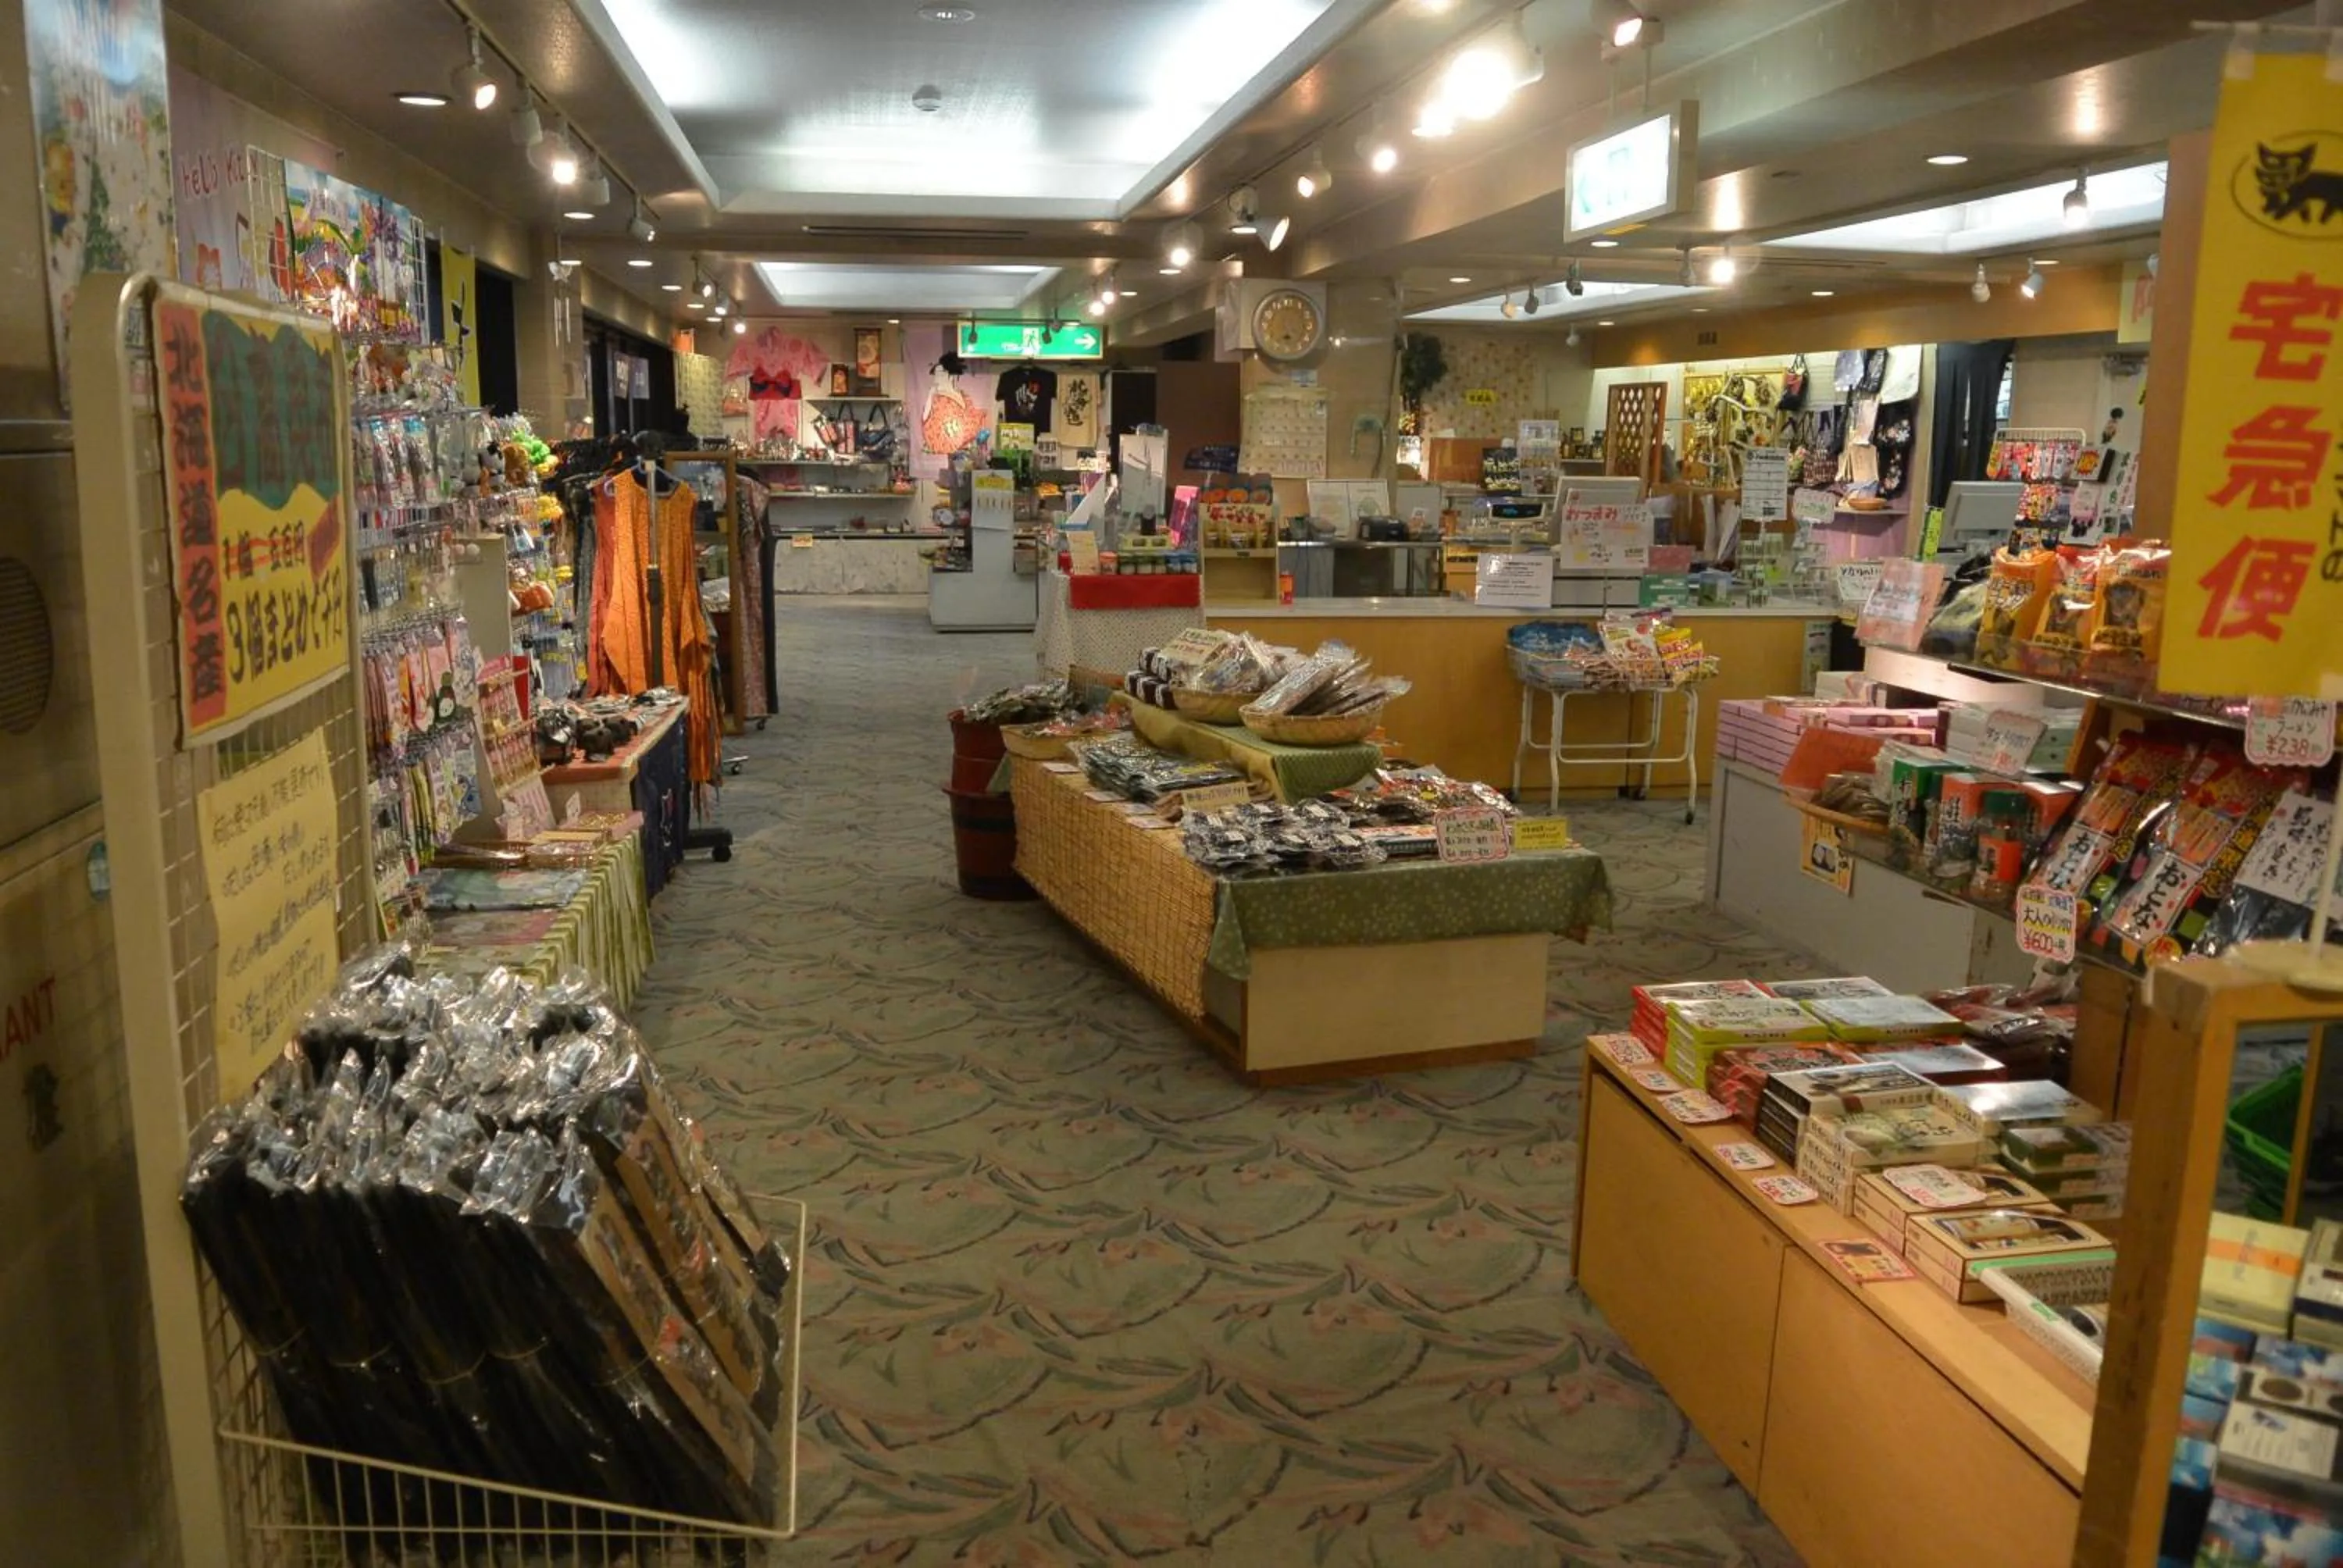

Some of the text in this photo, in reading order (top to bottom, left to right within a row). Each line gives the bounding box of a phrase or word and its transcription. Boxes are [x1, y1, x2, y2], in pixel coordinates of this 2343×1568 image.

[2198, 273, 2341, 643] 宅急便
[0, 971, 56, 1060] ANT
